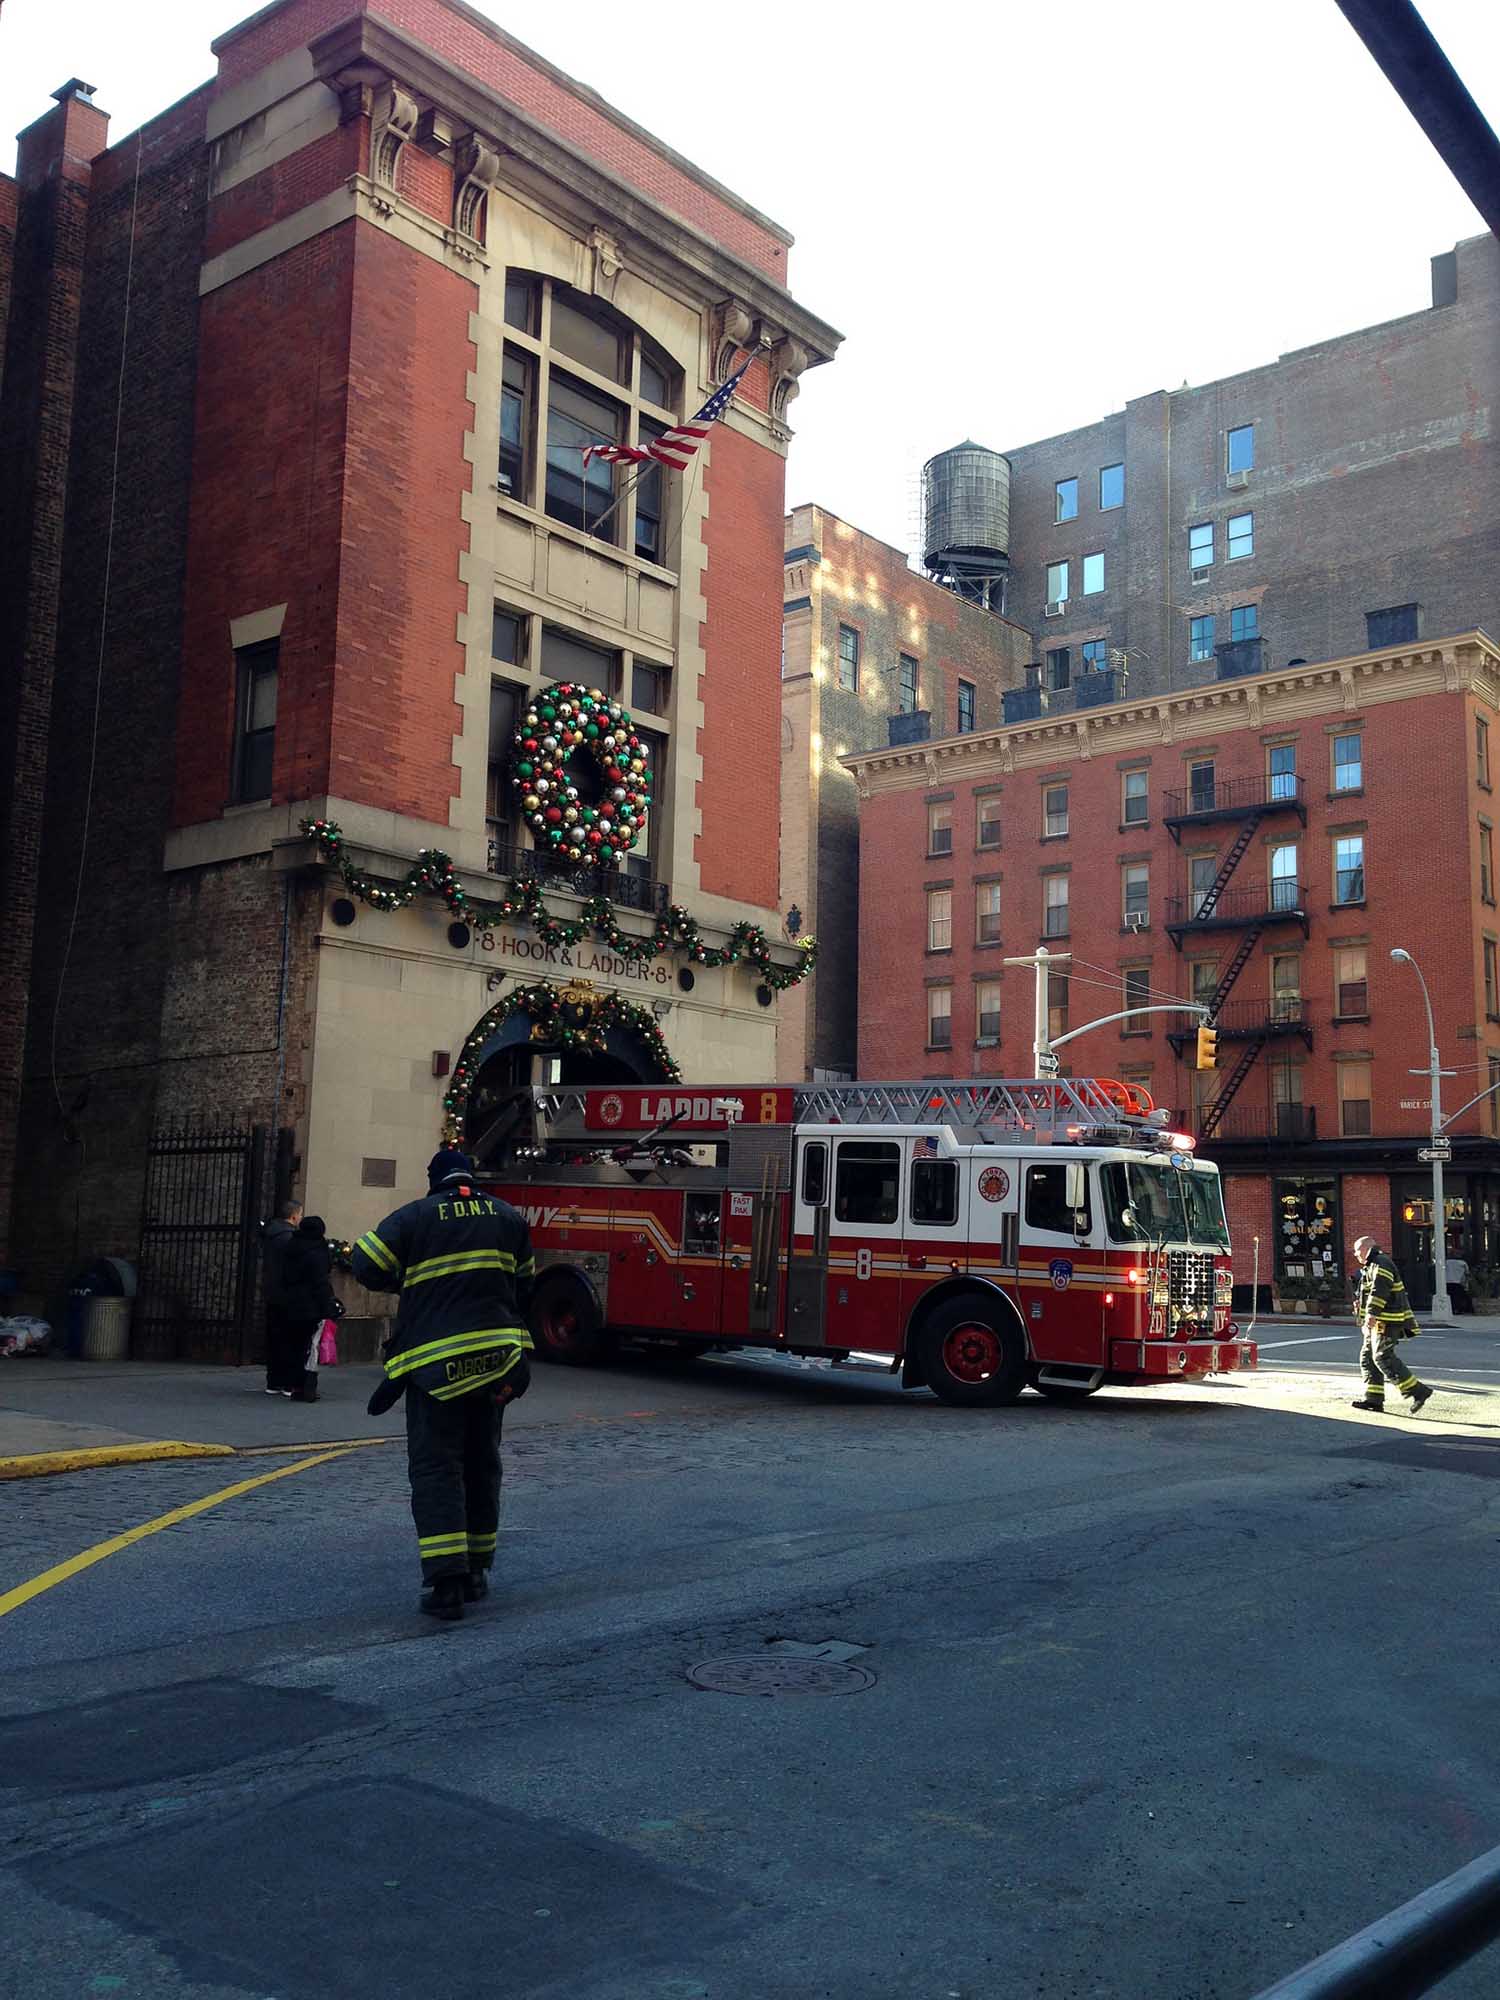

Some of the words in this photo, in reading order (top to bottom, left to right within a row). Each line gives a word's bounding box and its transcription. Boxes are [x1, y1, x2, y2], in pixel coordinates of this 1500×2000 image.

[502, 936, 557, 963] HOOK
[560, 948, 574, 967] &
[577, 951, 650, 980] LADDER
[760, 1092, 777, 1124] 8
[733, 1196, 750, 1205] FAST
[855, 1248, 873, 1281] 8
